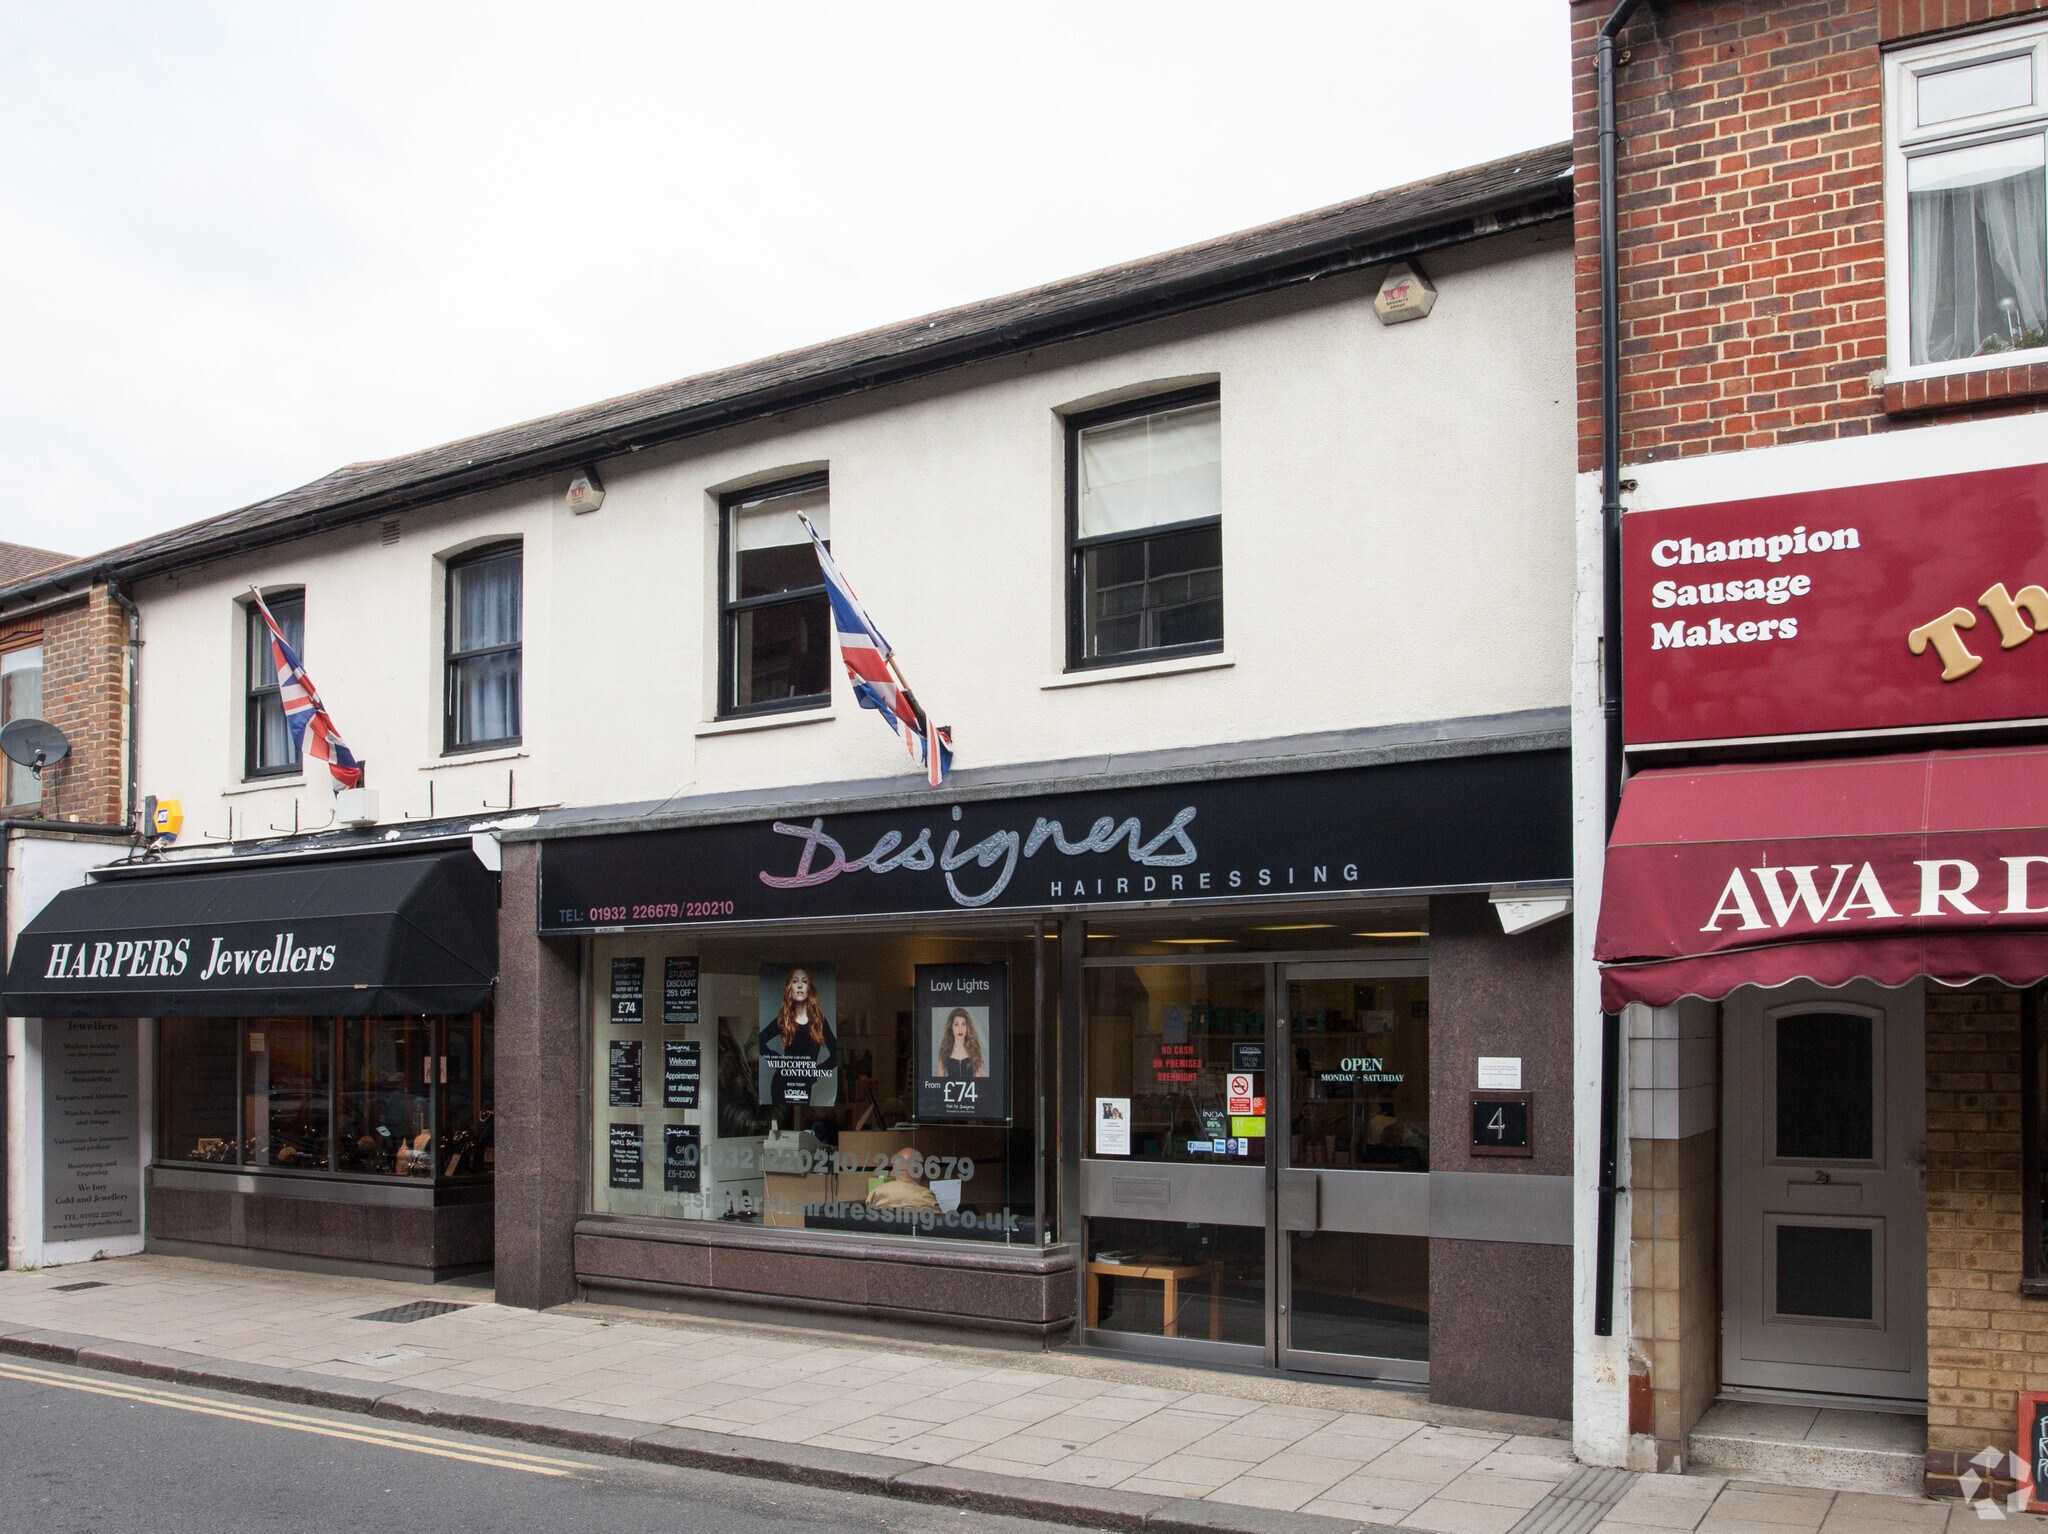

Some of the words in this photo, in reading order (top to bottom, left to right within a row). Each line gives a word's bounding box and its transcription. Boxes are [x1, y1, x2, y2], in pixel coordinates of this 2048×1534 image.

[1651, 526, 1860, 568] Champion
[1651, 573, 1811, 610] Sausage
[1651, 616, 1798, 651] Makers
[759, 806, 1198, 906] Designers
[1050, 863, 1360, 898] HAIRDRESSING
[559, 908, 584, 923] TEL:
[589, 905, 627, 922] 01932
[632, 900, 735, 920] 226679/220210
[44, 938, 191, 979] HARPERS
[200, 932, 337, 981] Jewellers
[668, 970, 696, 978] STUDENT
[666, 979, 696, 988] DISCOUNT
[930, 979, 953, 992] Low
[957, 978, 990, 993] Lights
[667, 989, 678, 997] 25%
[618, 1002, 636, 1013] £74
[67, 1020, 118, 1032] Jewellers
[1174, 1045, 1194, 1055] CASH
[668, 1057, 697, 1066] Welcome
[767, 1060, 786, 1068] WILD
[786, 1060, 817, 1069] COPPER
[1165, 1059, 1202, 1069] PREMISES
[1340, 1058, 1383, 1072] OPEN
[665, 1072, 699, 1080] Appointments
[780, 1069, 832, 1078] CONTOURING
[1156, 1073, 1197, 1082] OVERNIGHT
[1321, 1074, 1354, 1082] MONDAY
[1363, 1074, 1405, 1082] SATURDAY
[677, 1084, 695, 1092] always
[925, 1081, 940, 1089] From
[943, 1081, 978, 1103] £74
[668, 1096, 693, 1104] necessary
[1487, 1107, 1505, 1140] 4
[763, 1147, 976, 1182] 220210/226679
[668, 1170, 696, 1178] £5-£200
[93, 1184, 107, 1192] buy
[55, 1197, 75, 1205] Gold
[76, 1195, 92, 1203] and
[94, 1193, 128, 1203] Jewellery
